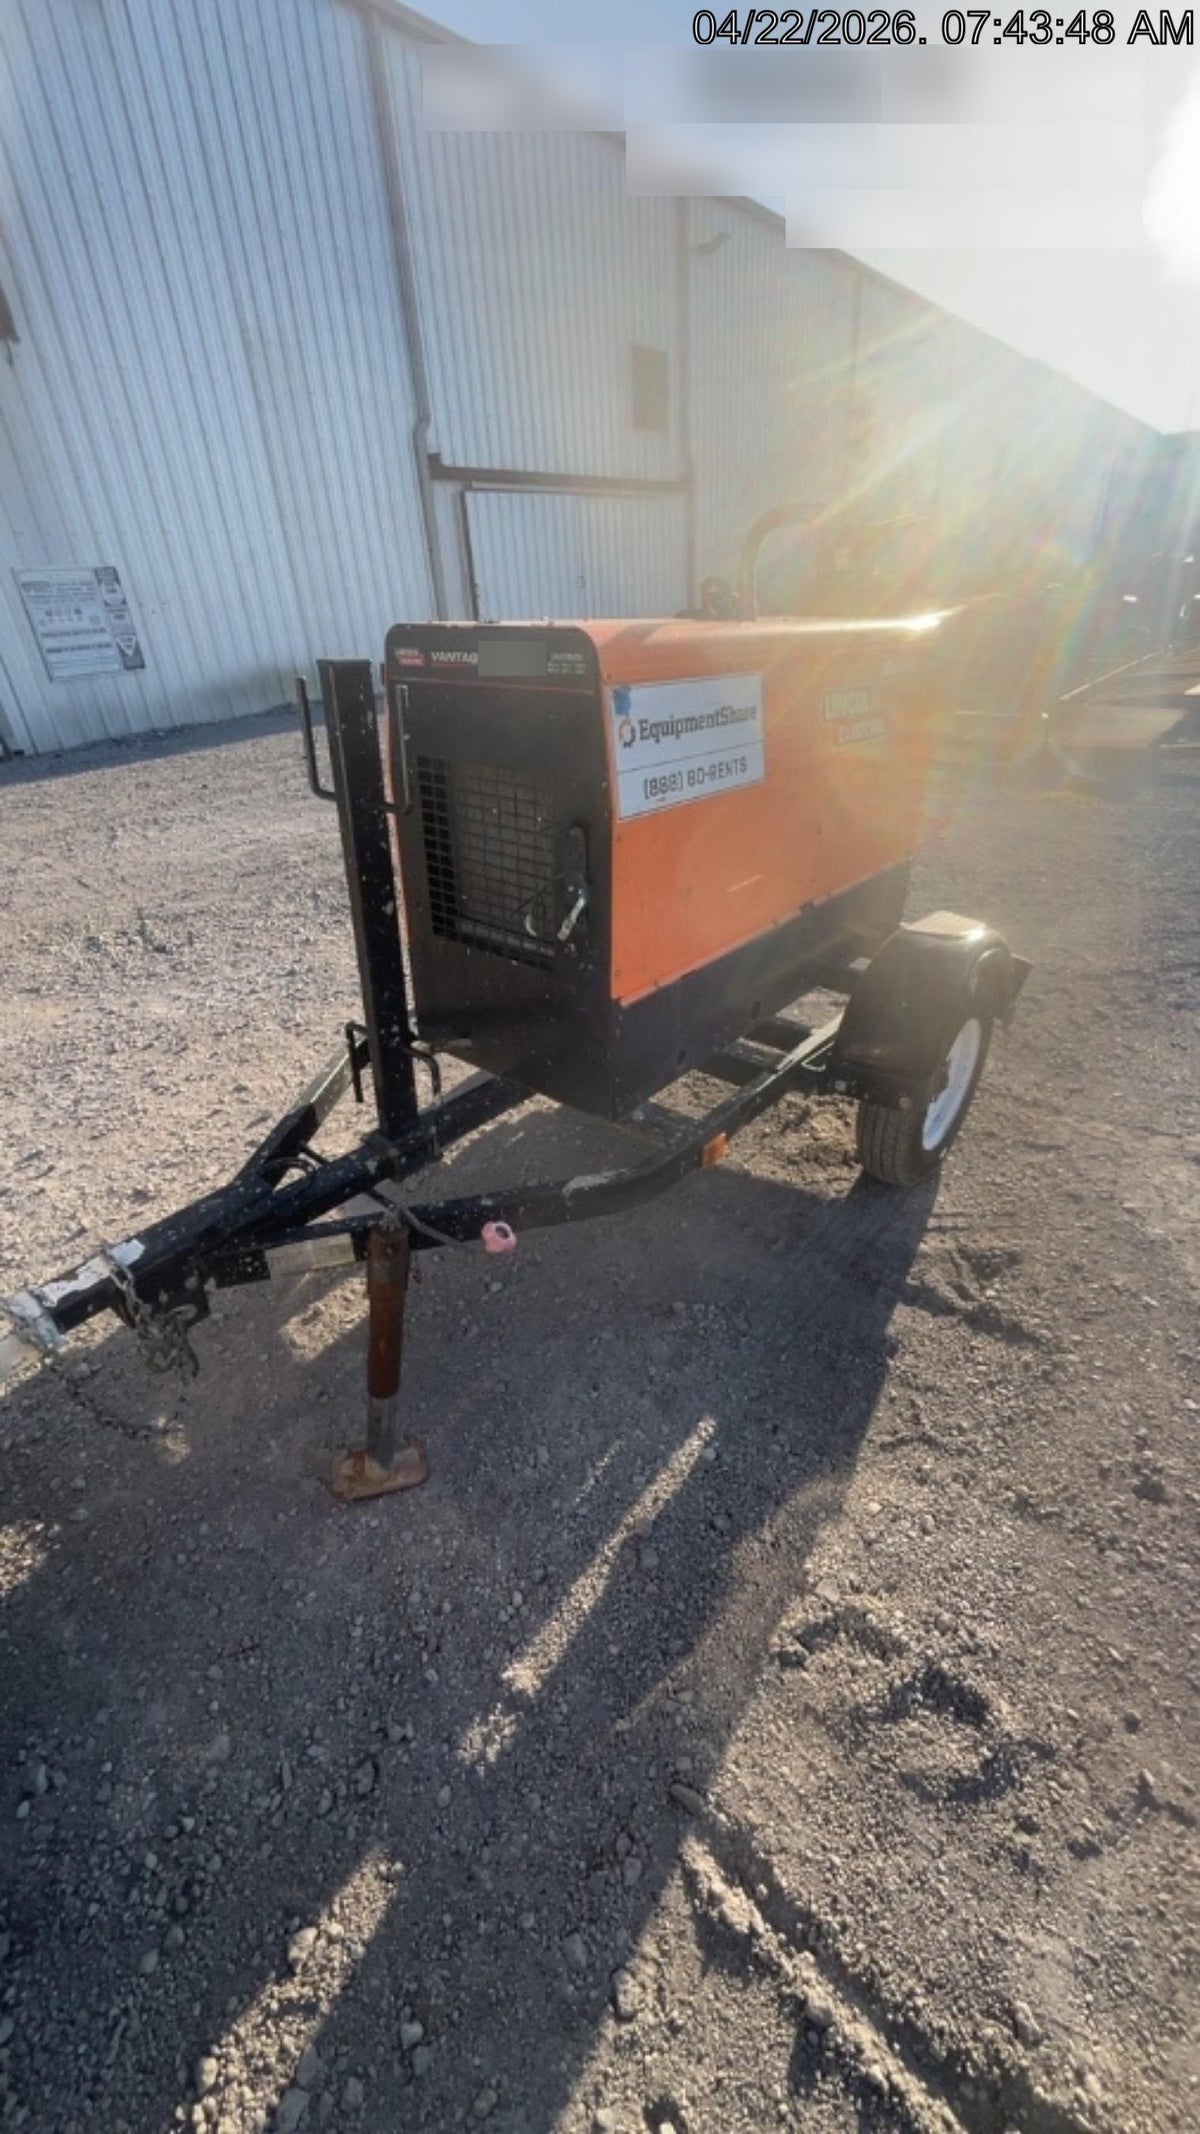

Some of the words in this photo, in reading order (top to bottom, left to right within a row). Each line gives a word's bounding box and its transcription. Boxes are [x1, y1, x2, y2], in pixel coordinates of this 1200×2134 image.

[431, 651, 479, 665] VANTAG
[638, 704, 758, 744] EquipmentShare
[643, 770, 684, 800] (888)
